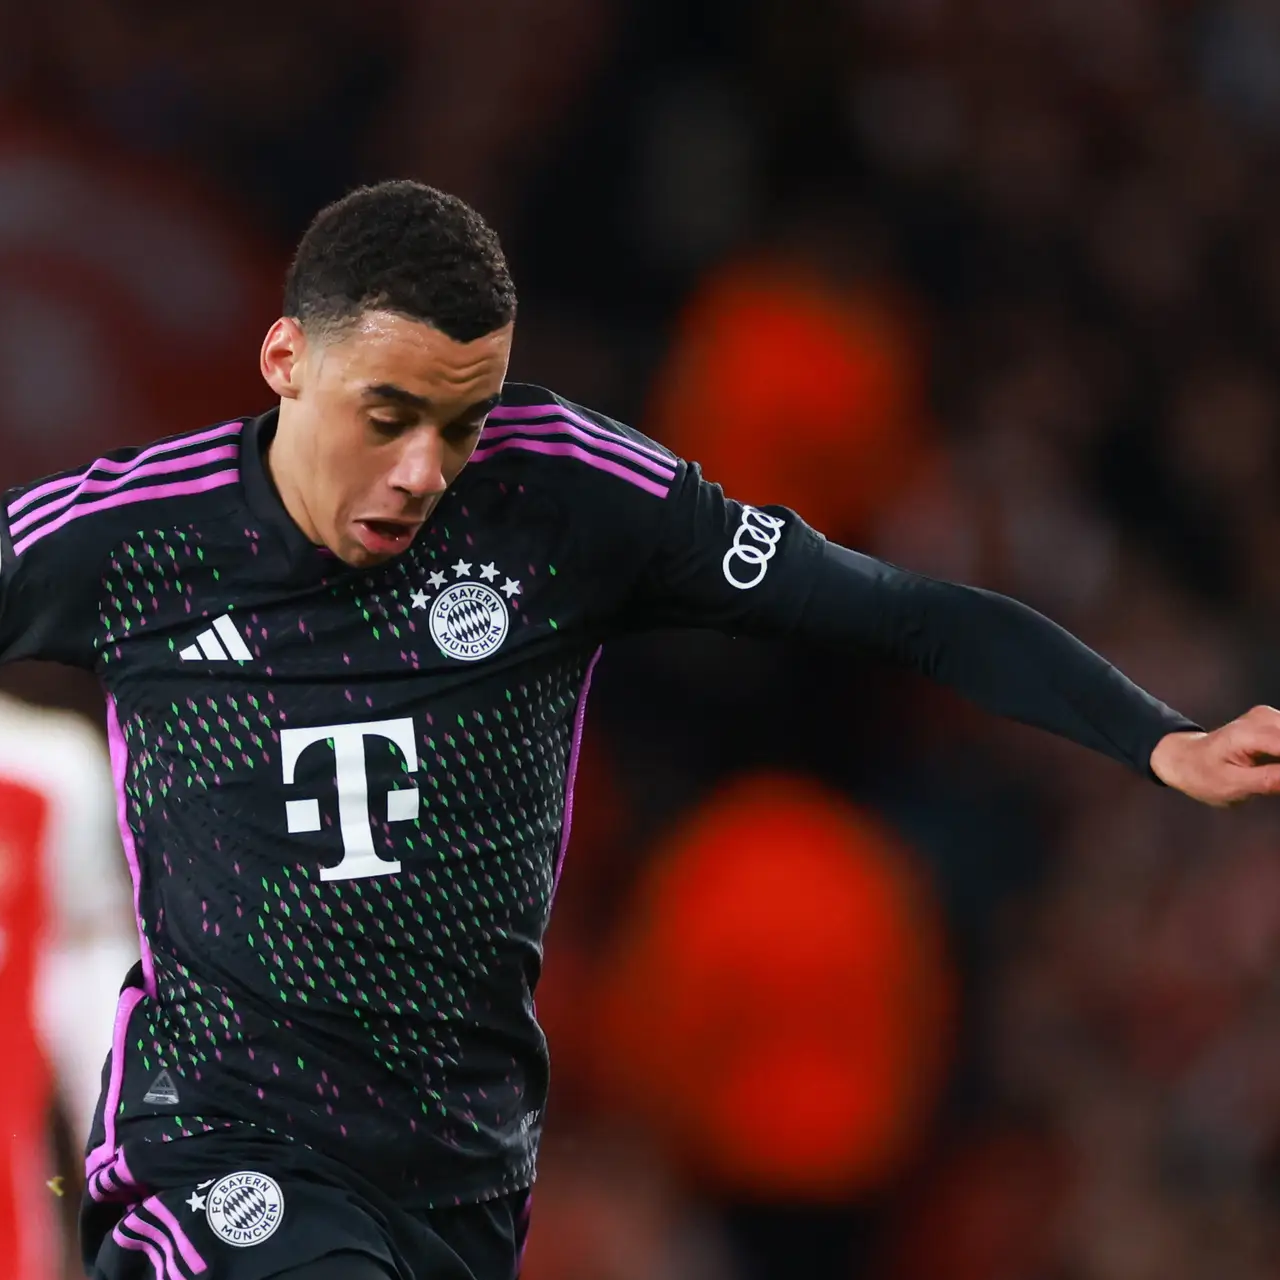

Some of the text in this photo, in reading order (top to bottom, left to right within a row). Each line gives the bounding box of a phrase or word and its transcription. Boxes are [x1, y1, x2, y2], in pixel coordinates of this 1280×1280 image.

[436, 588, 500, 619] FC BAYERN
[280, 716, 420, 882] T
[212, 1176, 271, 1214] FC BAYERN
